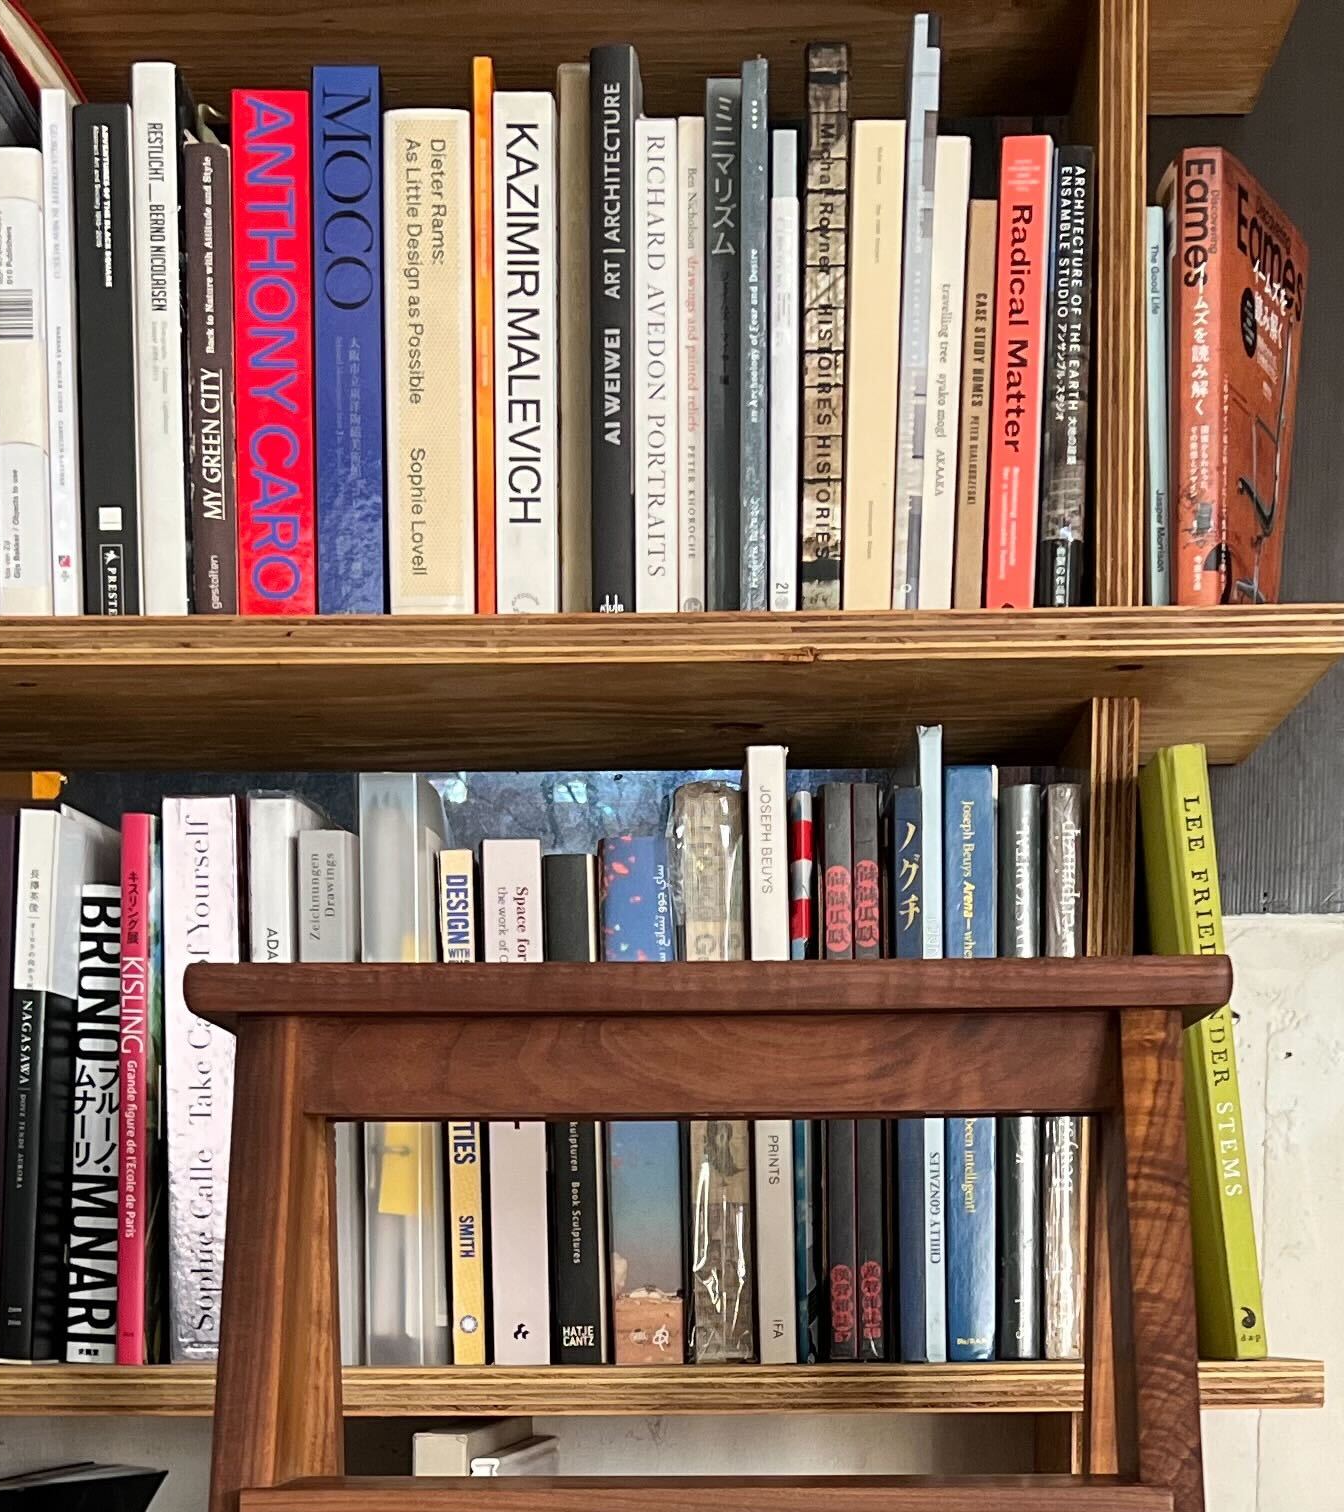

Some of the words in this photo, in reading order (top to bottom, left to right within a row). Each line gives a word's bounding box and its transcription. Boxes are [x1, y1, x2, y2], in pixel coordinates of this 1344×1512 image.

[406, 139, 420, 163] As
[430, 139, 444, 194] Dieter
[604, 83, 621, 242] ARCHITECTURE
[712, 97, 737, 255] ミニマリズム
[322, 87, 374, 310] MOCO
[406, 167, 421, 217] Little
[505, 123, 540, 298] KAZIMIR
[646, 136, 666, 271] RICHARD
[1058, 166, 1072, 250] ENSAMBLE
[1183, 157, 1216, 288] Eames
[244, 98, 297, 413] ANTHONY
[405, 224, 422, 290] Design
[432, 199, 447, 265] Rams:
[1071, 166, 1086, 288] ARCHITECTURE
[605, 260, 621, 299] ART
[1007, 204, 1033, 325] Radical
[1057, 257, 1069, 318] STUDIO
[409, 295, 421, 317] as
[1070, 324, 1081, 353] THE
[1071, 295, 1082, 315] OF
[408, 322, 425, 404] Possible
[605, 328, 621, 418] WEIWEI
[647, 284, 666, 400] AVEDON
[817, 304, 833, 425] HISTOIRES
[201, 368, 220, 414] CITY
[507, 308, 542, 524] MALEVICH
[1004, 340, 1029, 453] Matter
[1067, 360, 1080, 410] EARTH
[202, 417, 220, 484] GREEN
[605, 422, 621, 445] AI
[203, 488, 221, 520] MY
[249, 425, 302, 601] CARO
[408, 448, 427, 516] Sophie
[647, 415, 666, 578] PORTRAITS
[815, 437, 832, 559] HISTORIES
[210, 555, 223, 610] gestalten
[411, 521, 427, 575] Lovell
[759, 785, 773, 843] JOSEPH
[185, 813, 211, 939] Yourself
[309, 852, 321, 941] Zeichnungen
[324, 851, 336, 918] Drawings
[760, 846, 774, 896] BEUYS
[898, 821, 921, 932] ノグチ
[126, 871, 139, 945] キスリング展
[445, 875, 471, 945] DESIGN
[76, 903, 121, 1061] BRUNO
[74, 1065, 96, 1168] ムナーリ
[189, 1059, 213, 1126] Take
[189, 1149, 214, 1220] Calle
[767, 1134, 781, 1185] PRINTS
[928, 1151, 941, 1215] GONZALES
[67, 1182, 118, 1343] MUNARI
[458, 1215, 475, 1258] SMITH
[929, 1217, 941, 1264] CHILLY
[562, 1326, 594, 1337] HATJE
[562, 1336, 595, 1347] CANTZ
